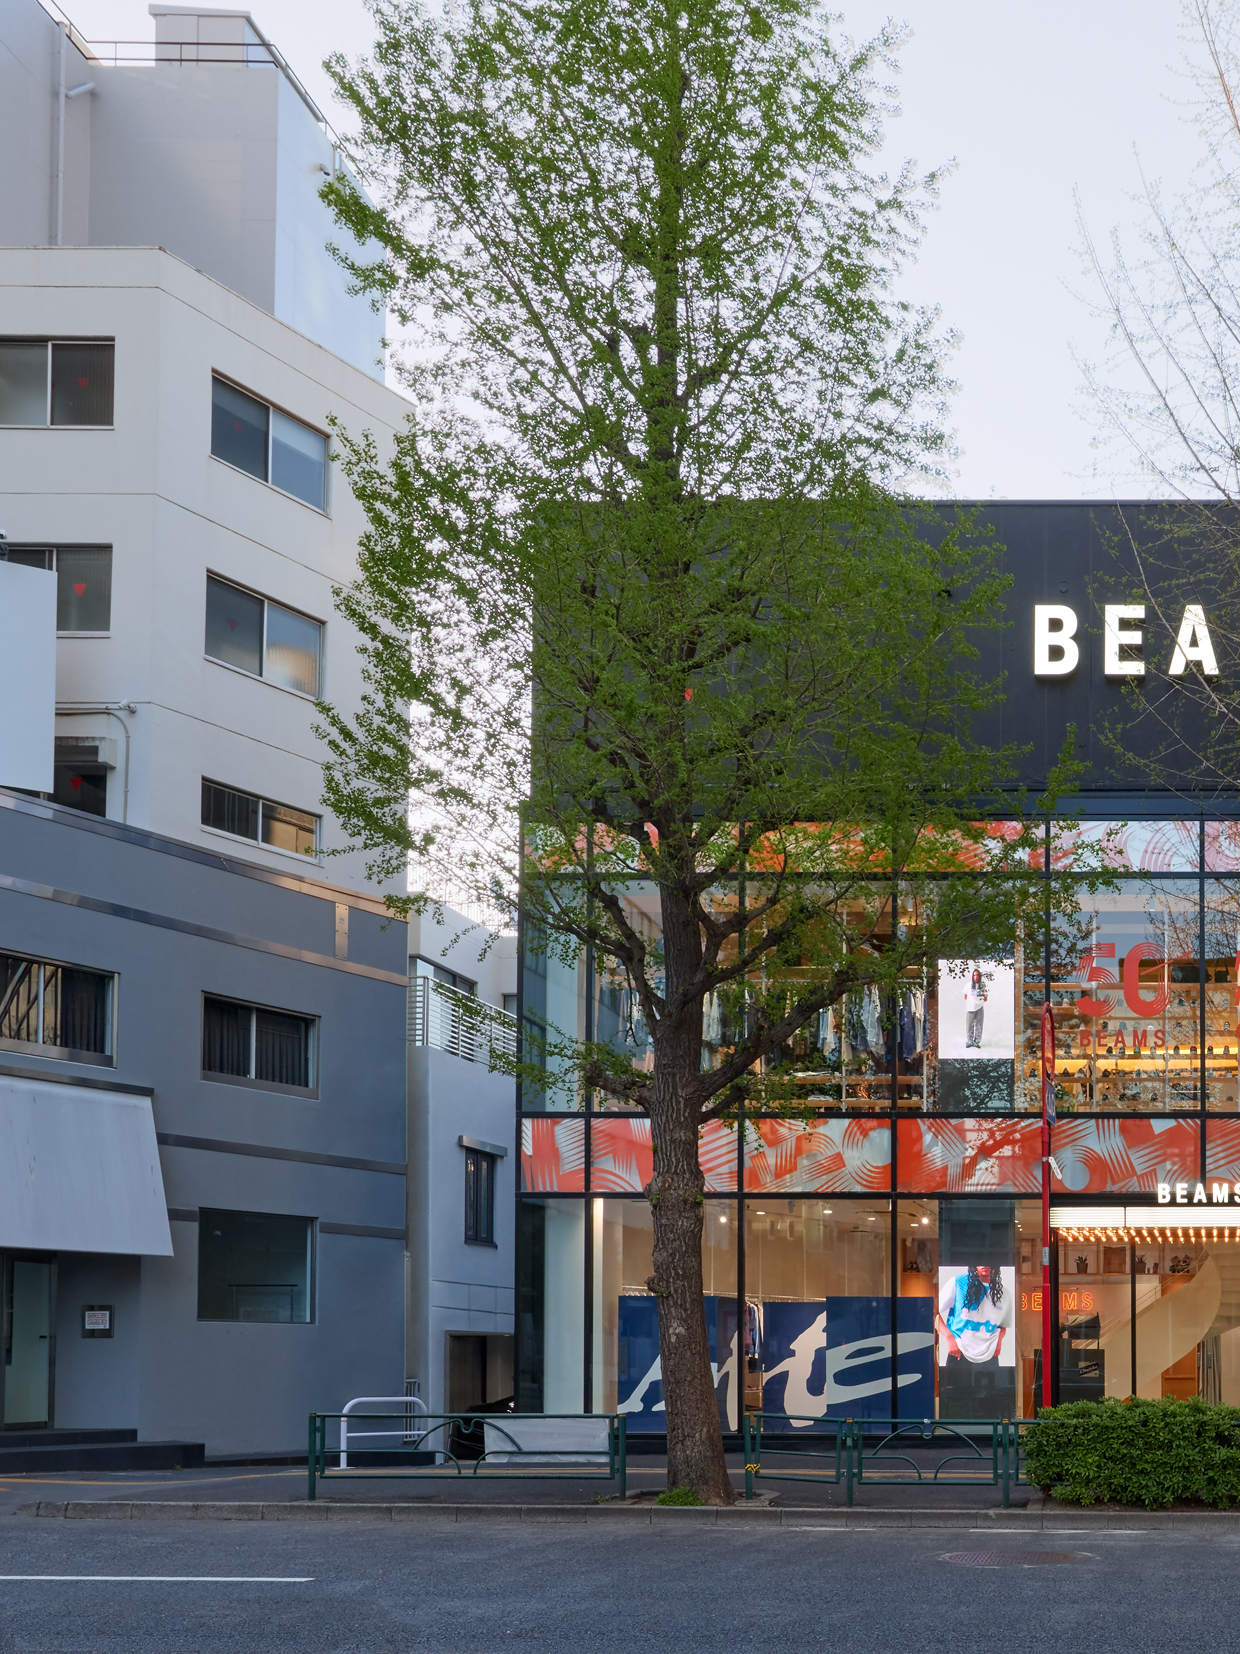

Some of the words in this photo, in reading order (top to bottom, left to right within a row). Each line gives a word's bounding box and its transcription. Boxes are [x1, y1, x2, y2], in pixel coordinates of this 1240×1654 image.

[1074, 941, 1180, 1018] 50
[1079, 1029, 1166, 1048] BEAMS
[1021, 1291, 1094, 1311] BEMS
